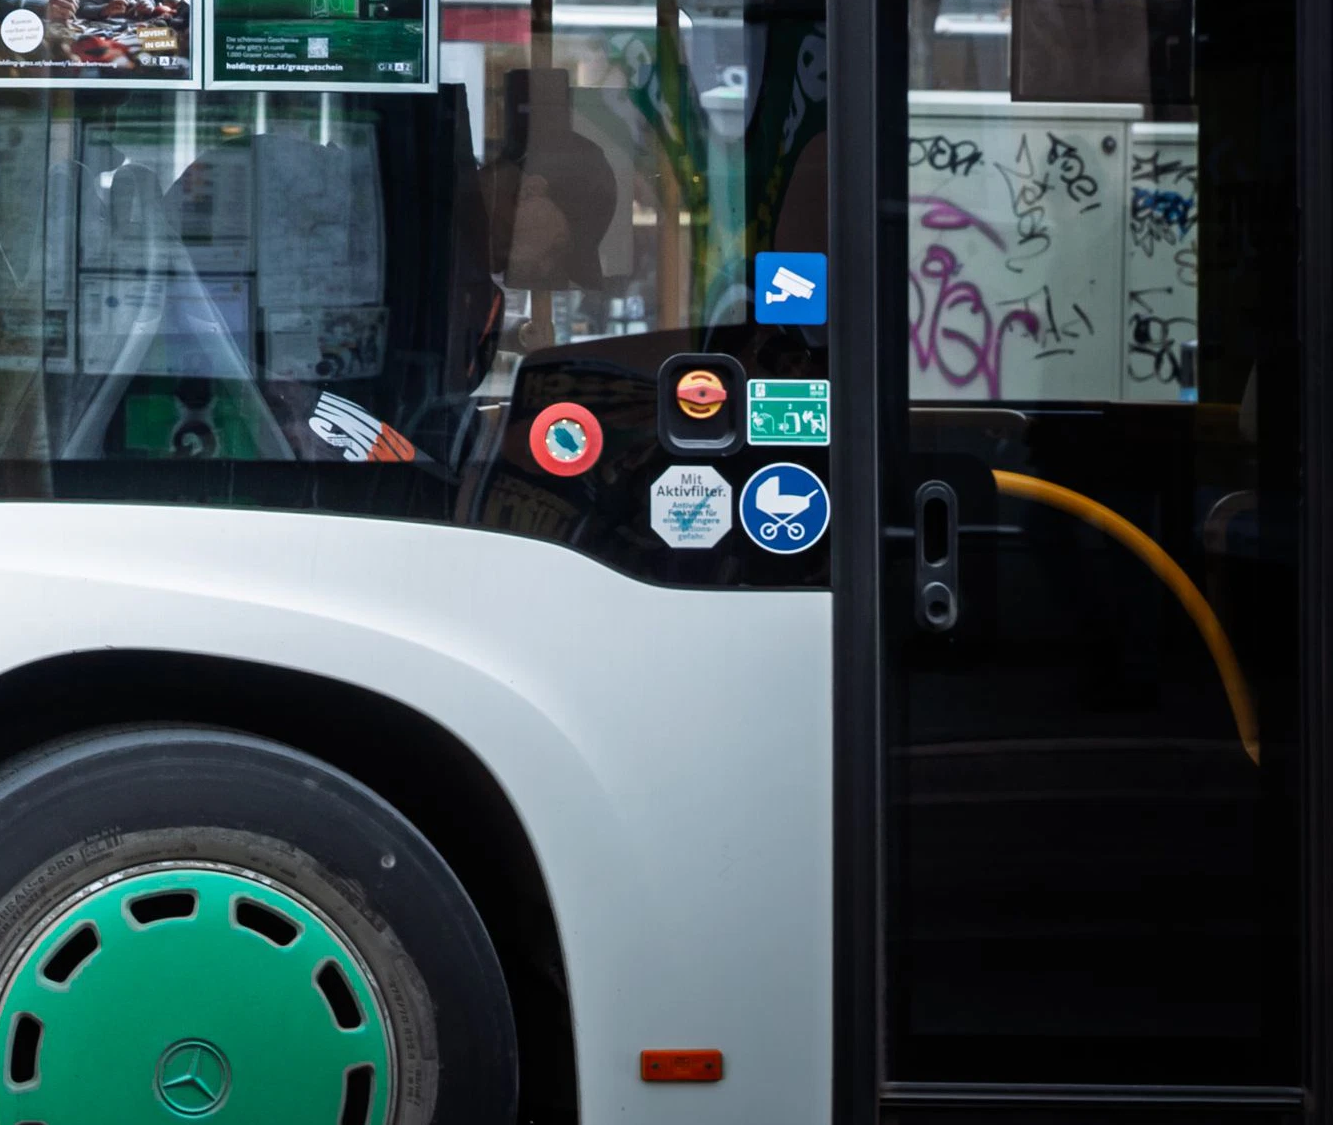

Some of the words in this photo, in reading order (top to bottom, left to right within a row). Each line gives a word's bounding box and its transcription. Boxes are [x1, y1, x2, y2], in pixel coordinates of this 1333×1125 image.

[226, 62, 344, 72] holding-graz.at/grazgutschein
[680, 473, 702, 485] Mit
[656, 485, 727, 497] Aktivfilter.
[705, 509, 717, 517] für
